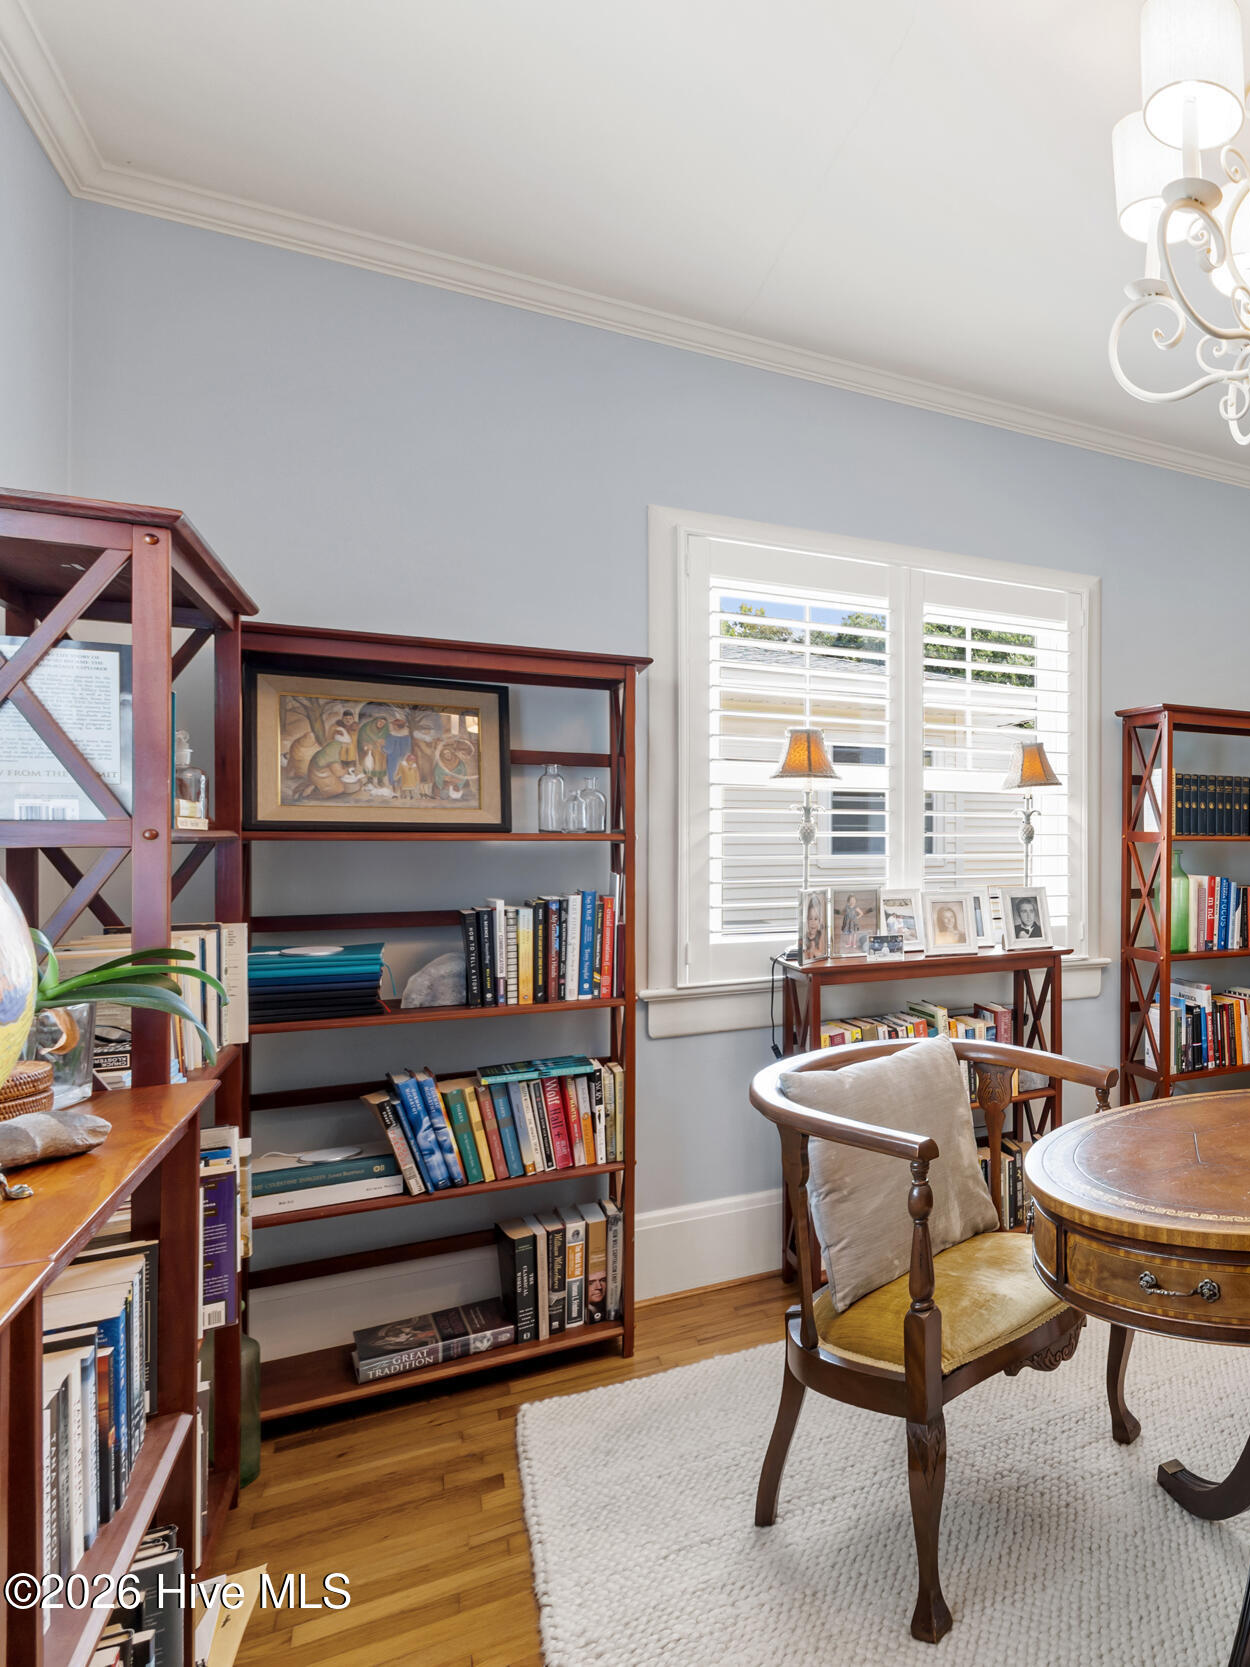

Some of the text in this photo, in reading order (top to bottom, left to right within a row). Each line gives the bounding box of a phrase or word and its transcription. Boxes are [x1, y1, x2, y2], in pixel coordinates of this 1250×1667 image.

[543, 1078, 560, 1105] Wolf
[552, 1232, 564, 1289] William Wilberforce
[367, 1356, 434, 1379] TRADITION
[392, 1349, 430, 1365] GREAT
